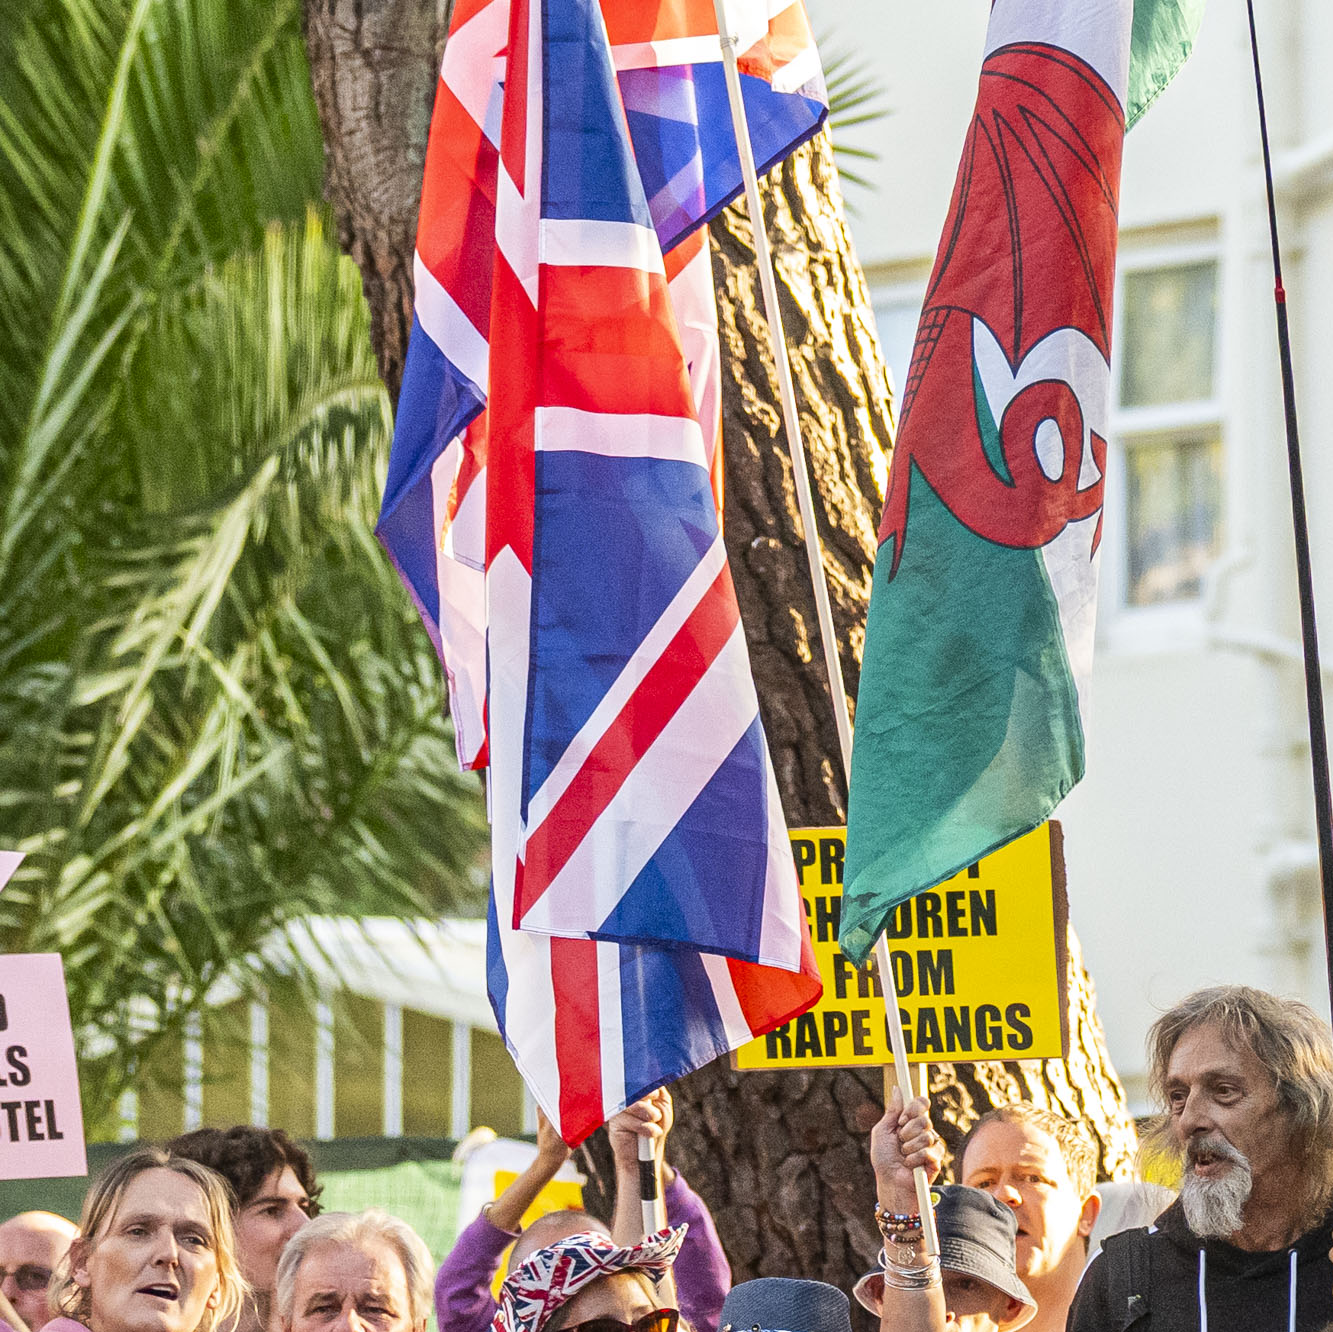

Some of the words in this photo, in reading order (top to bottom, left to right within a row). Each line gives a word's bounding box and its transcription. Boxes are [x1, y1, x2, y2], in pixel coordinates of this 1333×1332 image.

[766, 1009, 874, 1060] RAPE
[885, 1003, 1034, 1054] GANGS
[0, 1099, 64, 1142] TEL
